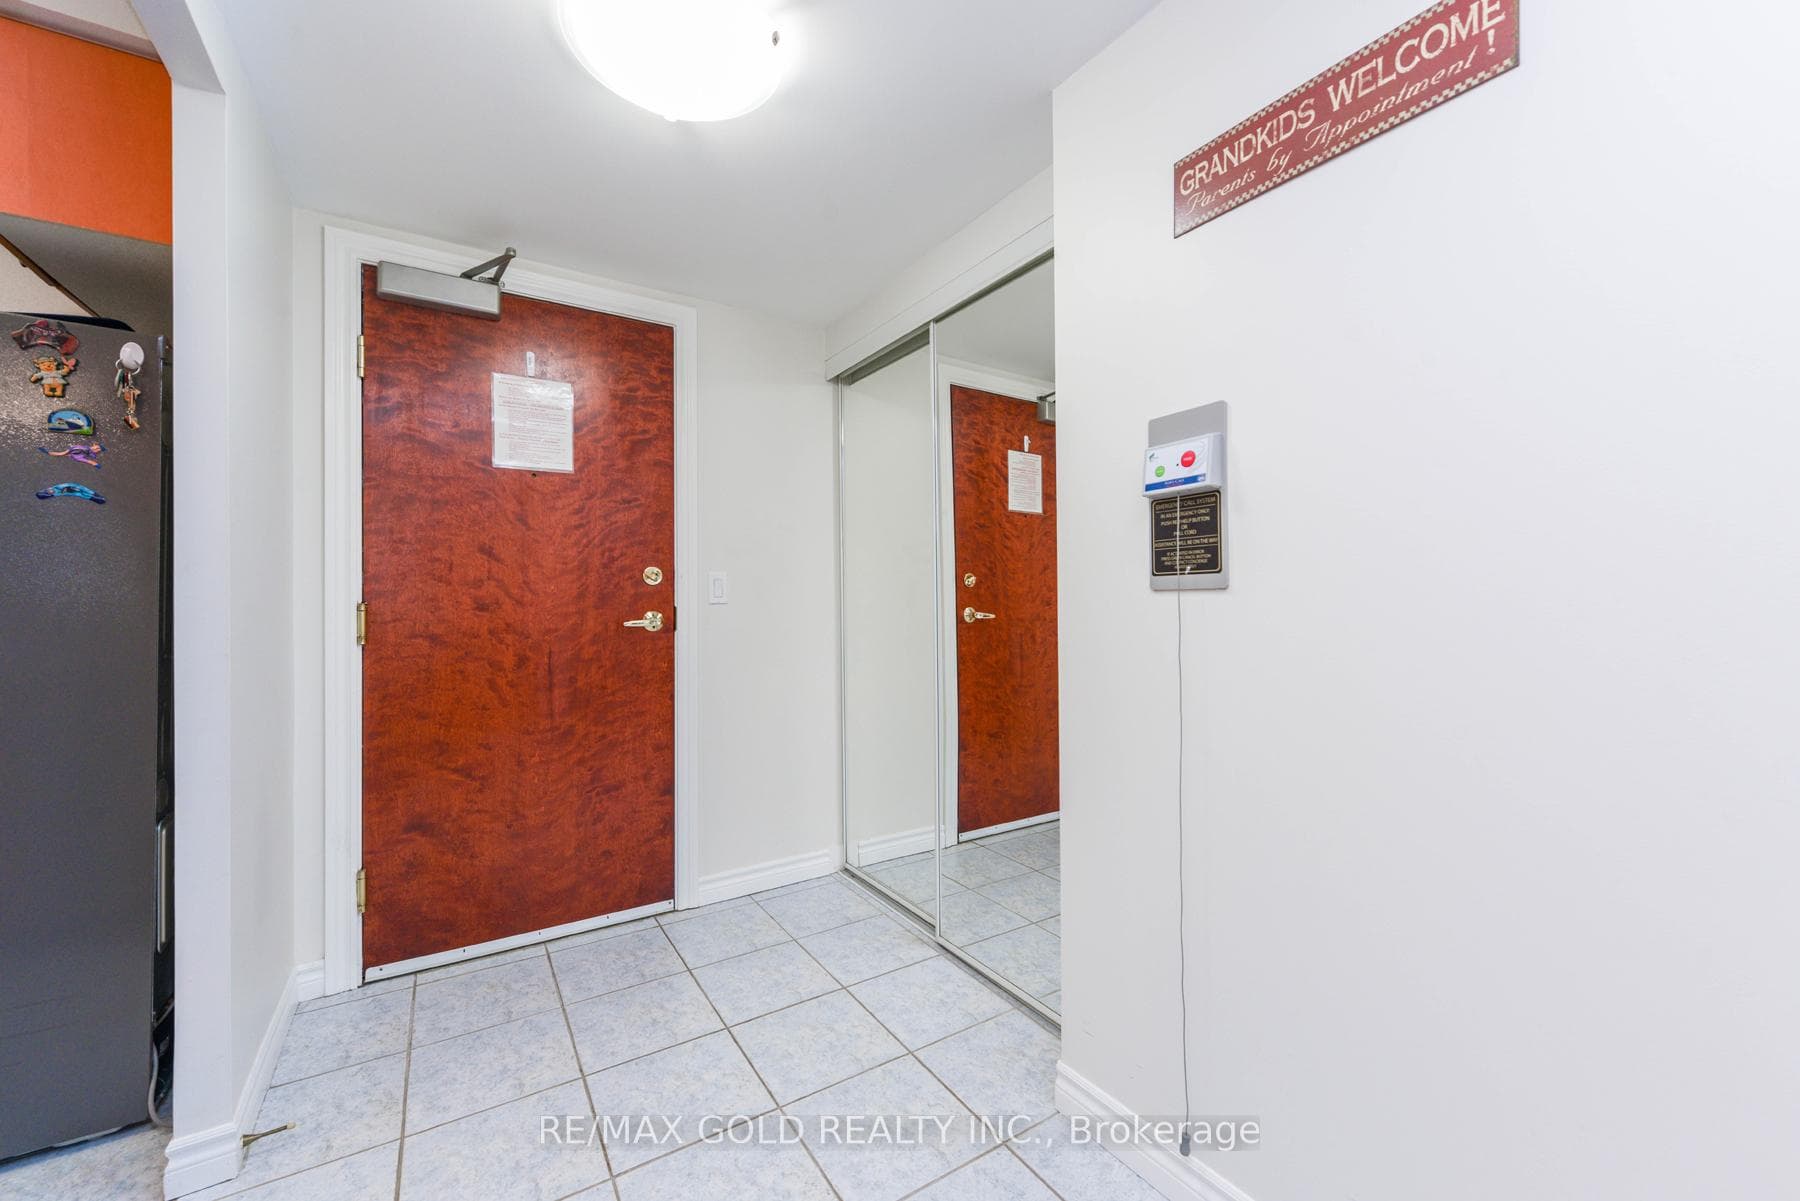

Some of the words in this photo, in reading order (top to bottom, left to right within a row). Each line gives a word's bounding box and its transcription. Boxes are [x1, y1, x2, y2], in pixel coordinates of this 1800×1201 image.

[1179, 98, 1317, 196] GRANDKIDS
[1184, 168, 1256, 216] Parents
[1266, 146, 1293, 176] by
[1156, 501, 1183, 510] EMERGENY
[1197, 496, 1216, 504] SYSTEM
[1172, 509, 1197, 518] EMRGENCY
